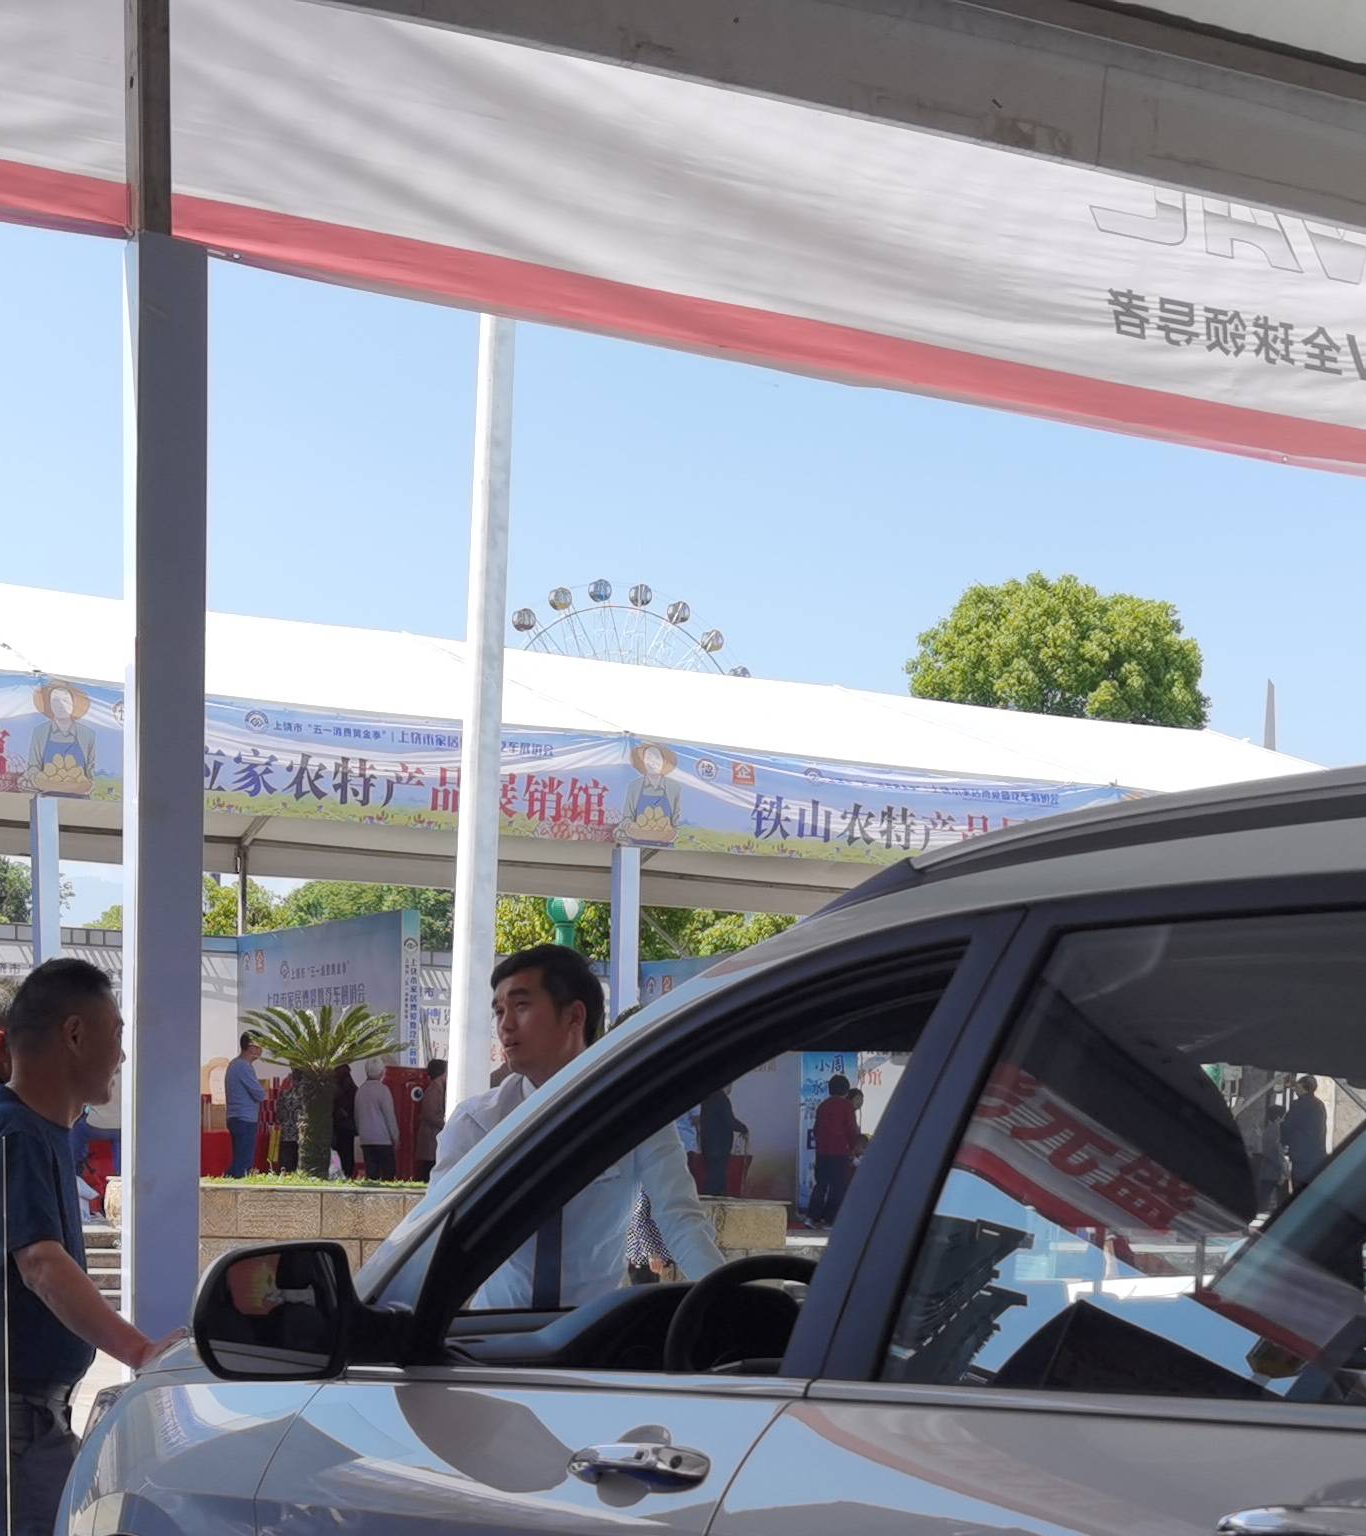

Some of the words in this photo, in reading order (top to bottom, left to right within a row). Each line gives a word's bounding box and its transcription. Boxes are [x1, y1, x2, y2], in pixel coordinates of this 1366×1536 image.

[750, 792, 1029, 852] 铁山农特产品
